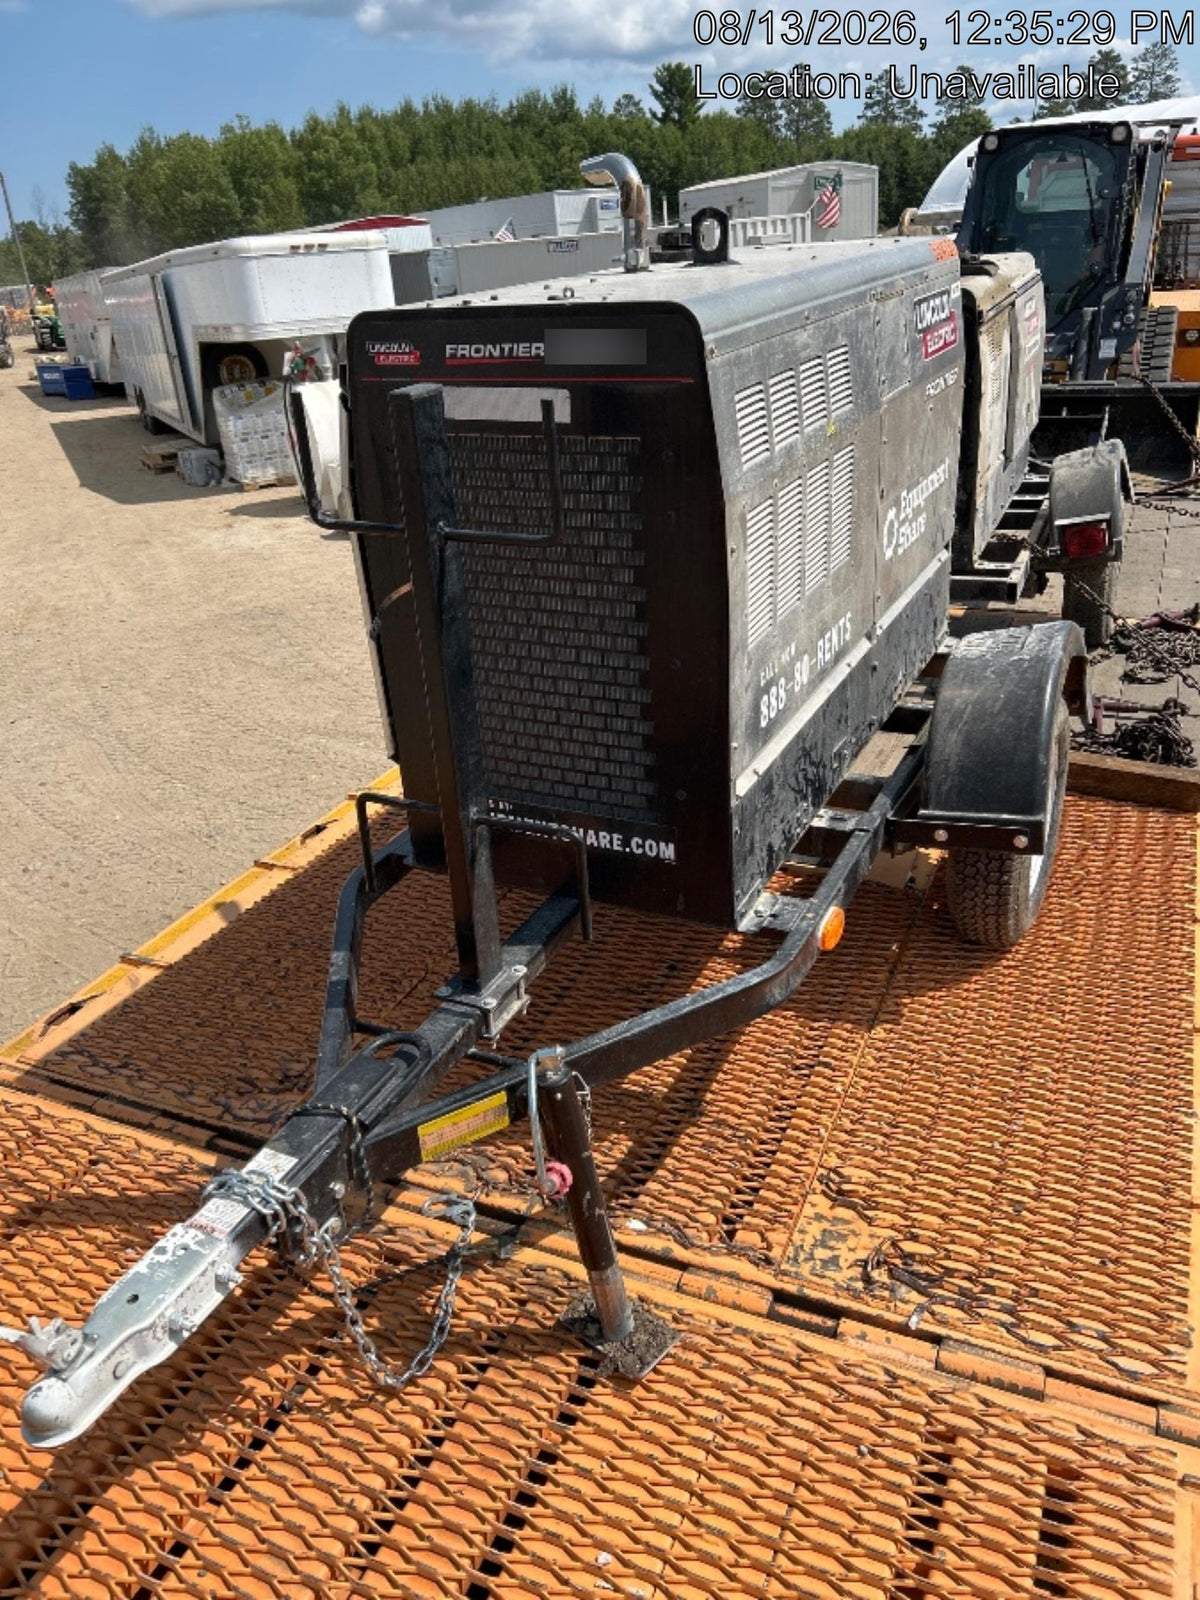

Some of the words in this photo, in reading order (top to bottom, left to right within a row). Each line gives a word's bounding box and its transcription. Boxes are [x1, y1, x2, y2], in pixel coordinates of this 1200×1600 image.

[445, 342, 545, 358] FRONTIER
[899, 457, 949, 521] Equipment
[897, 512, 927, 556] Share
[760, 611, 852, 728] 888-80-RENTS
